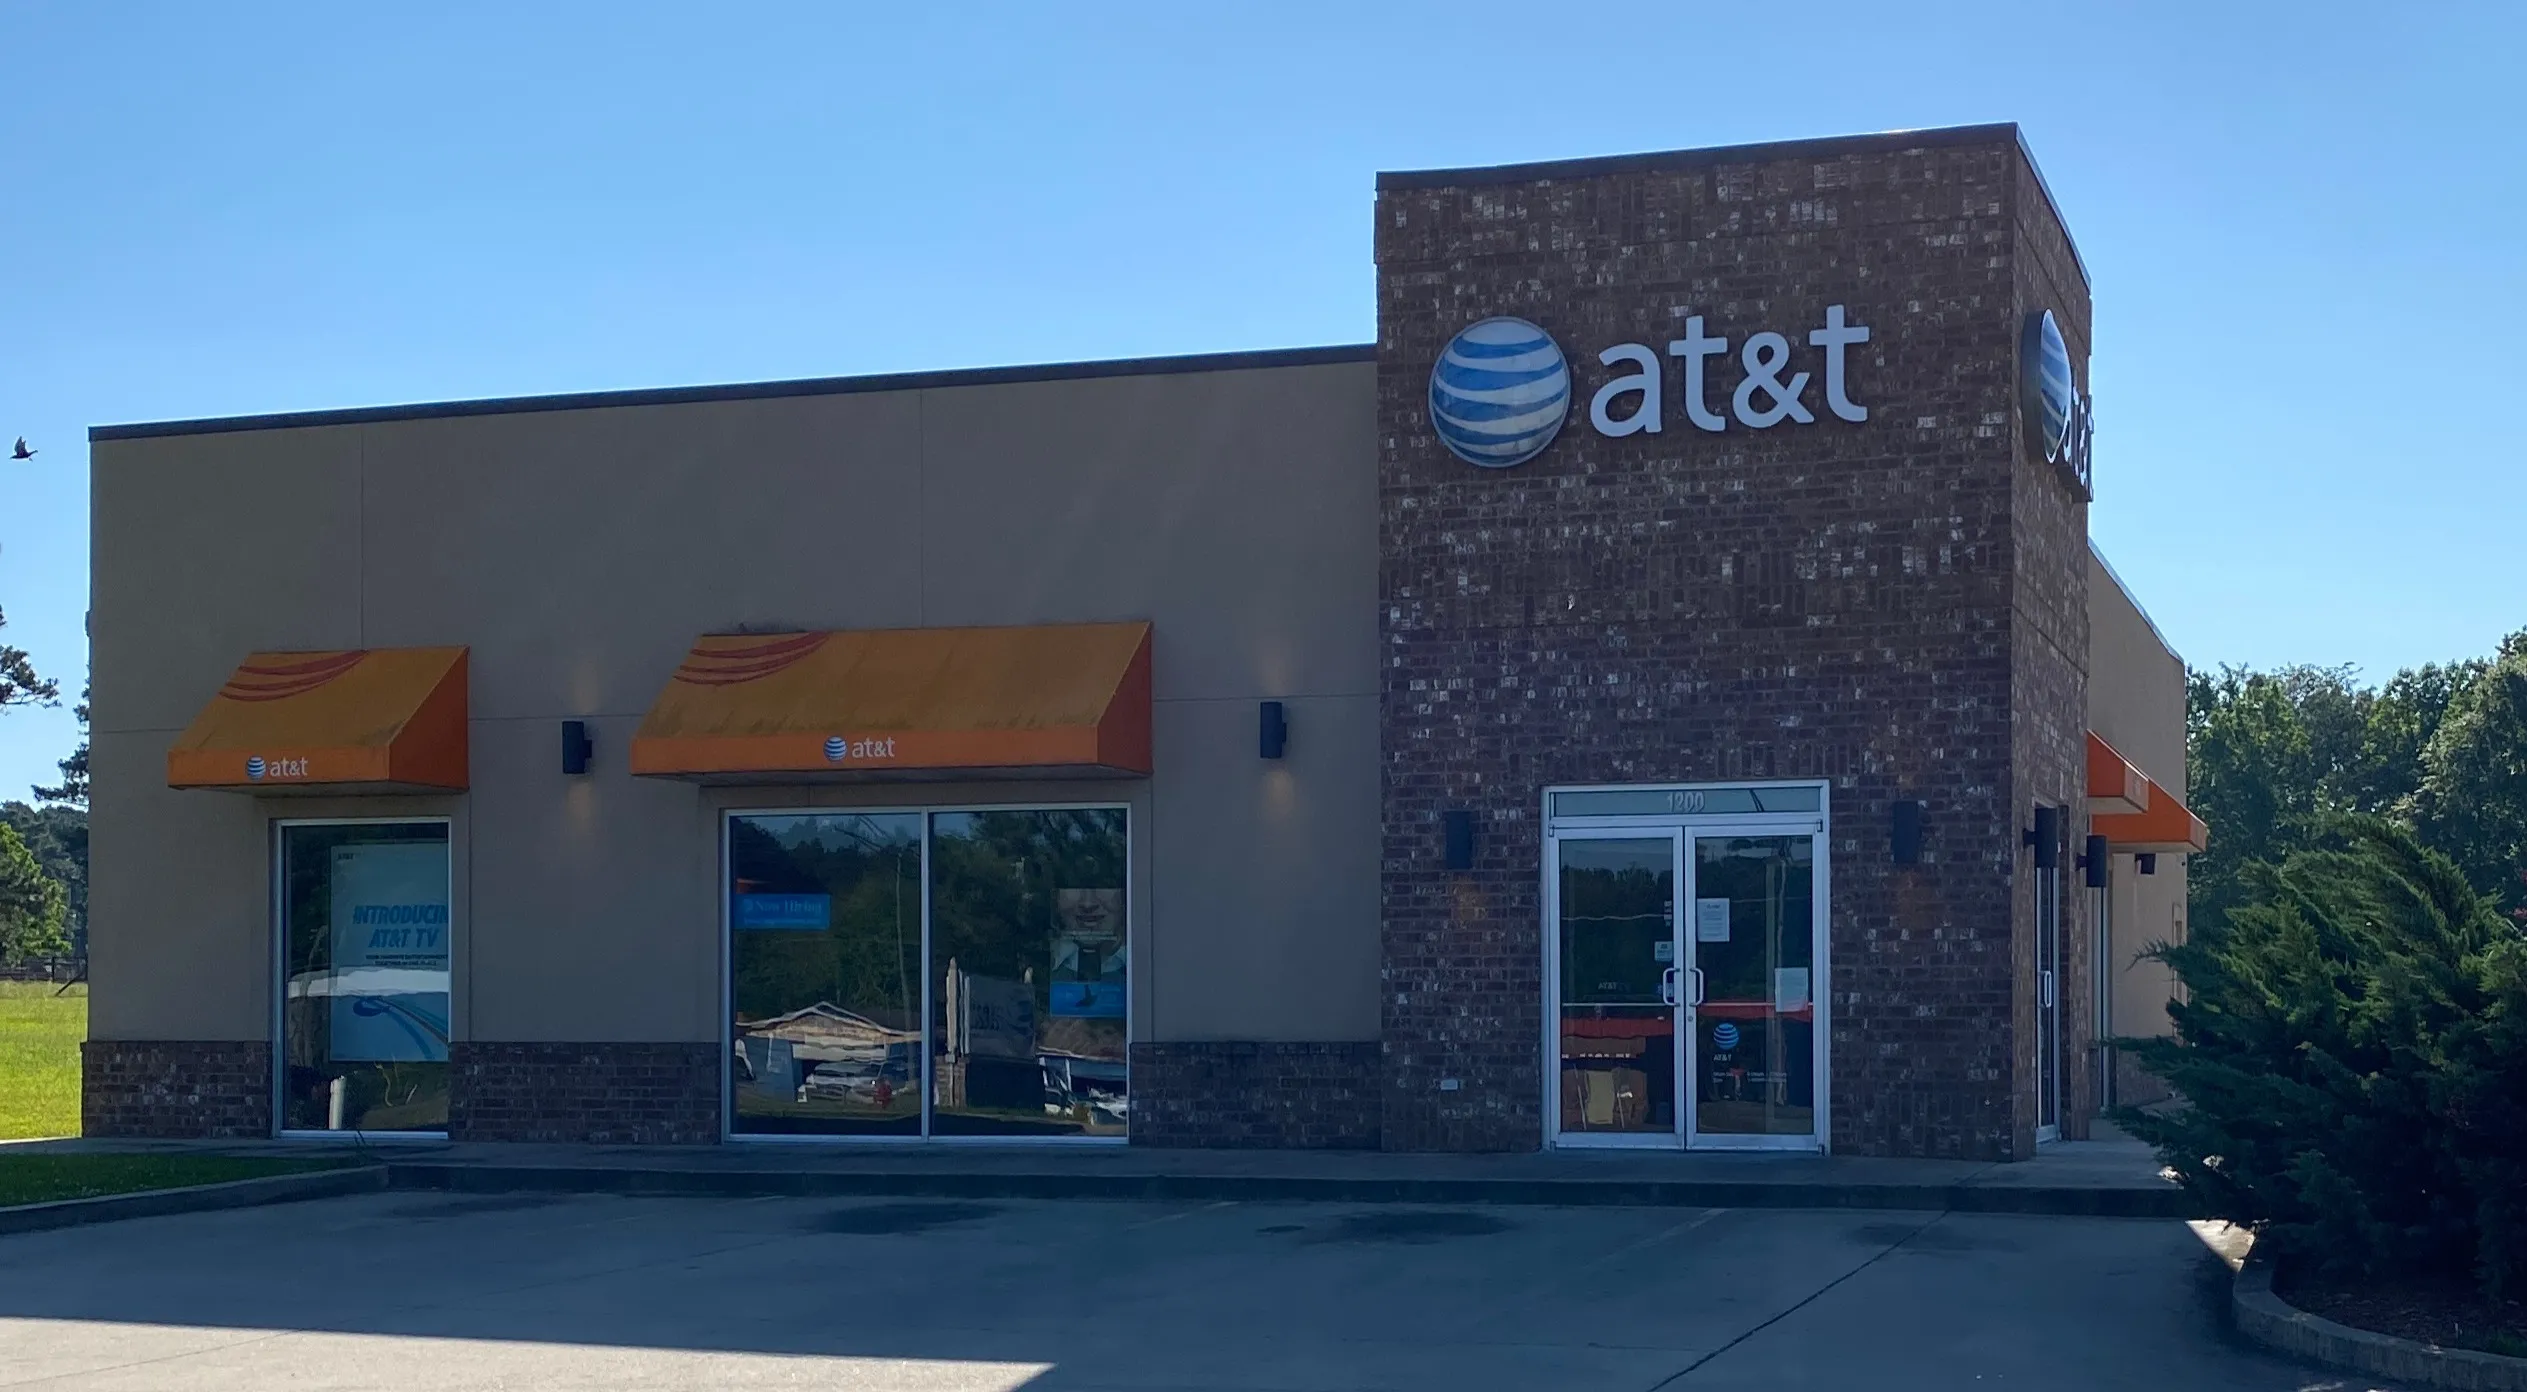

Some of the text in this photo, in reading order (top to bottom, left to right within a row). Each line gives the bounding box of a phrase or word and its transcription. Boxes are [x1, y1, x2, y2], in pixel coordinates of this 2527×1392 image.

[1589, 304, 1870, 438] at&t
[852, 736, 895, 759] at&t
[270, 756, 309, 777] at&t
[1666, 791, 1706, 813] 1200
[368, 928, 440, 948] AT&T TV
